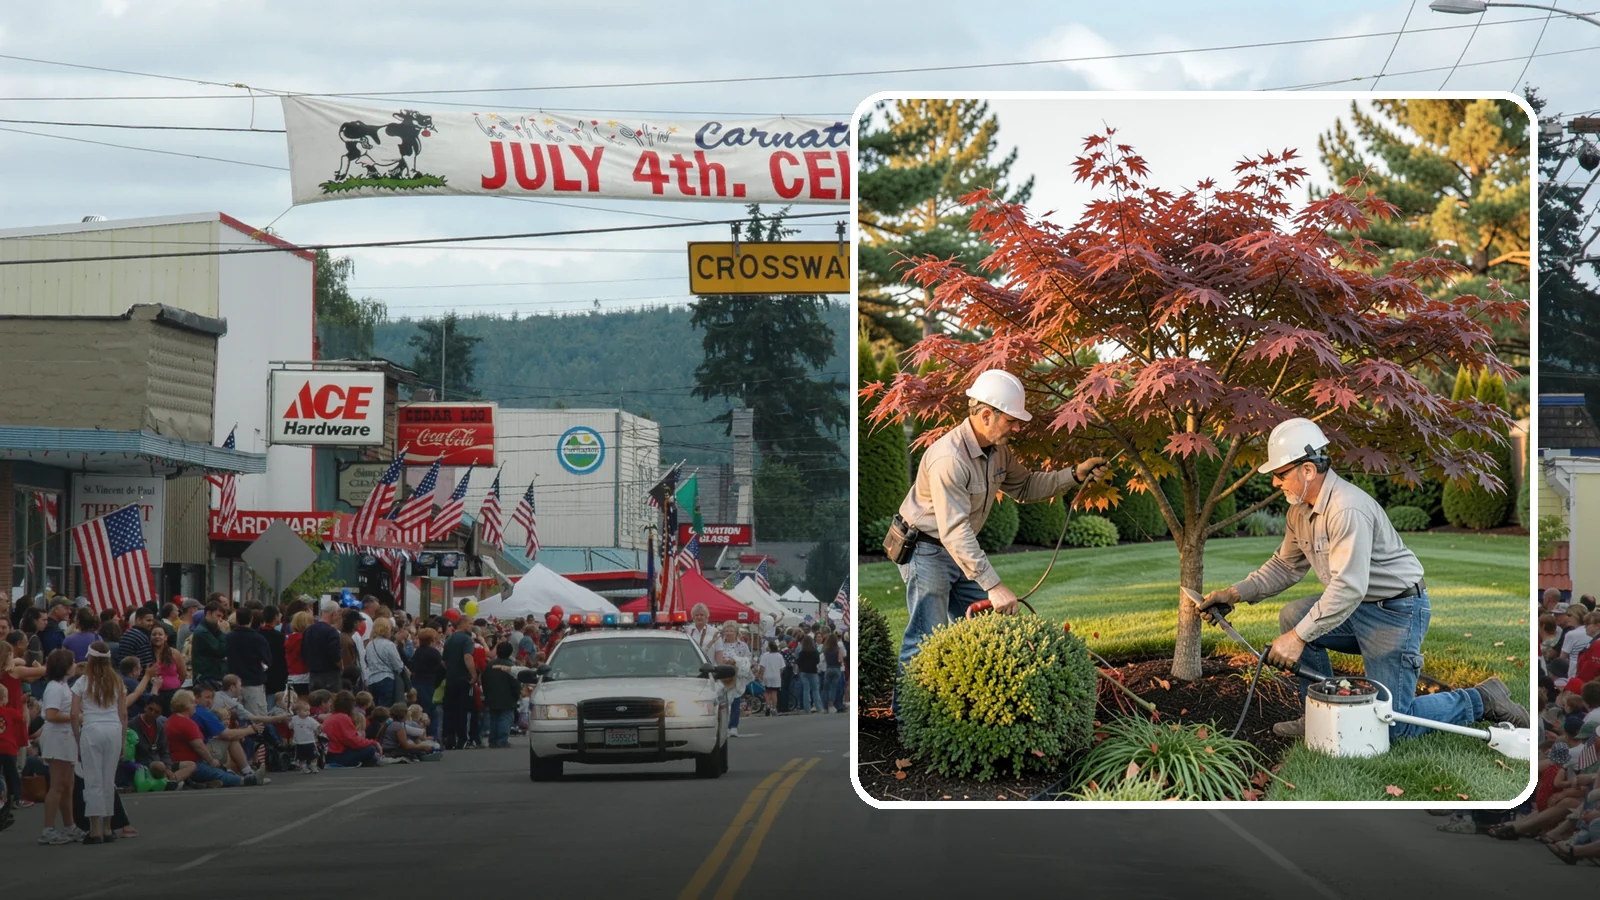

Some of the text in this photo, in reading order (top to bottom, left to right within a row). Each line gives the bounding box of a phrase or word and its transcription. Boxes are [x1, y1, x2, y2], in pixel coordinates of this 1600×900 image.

[481, 141, 605, 192] JULY
[632, 150, 746, 198] 4th.
[697, 254, 850, 280] CROSSWA
[283, 380, 373, 420] ACE
[406, 409, 452, 421] CEDAR
[283, 421, 370, 436] Hardware
[416, 428, 476, 447] Coca-Cola
[353, 467, 385, 479] Simpl
[83, 484, 155, 495] St. Vincent de Paul
[81, 503, 154, 522] THT
[688, 526, 742, 535] CRNATION
[699, 535, 730, 543] GLASS
